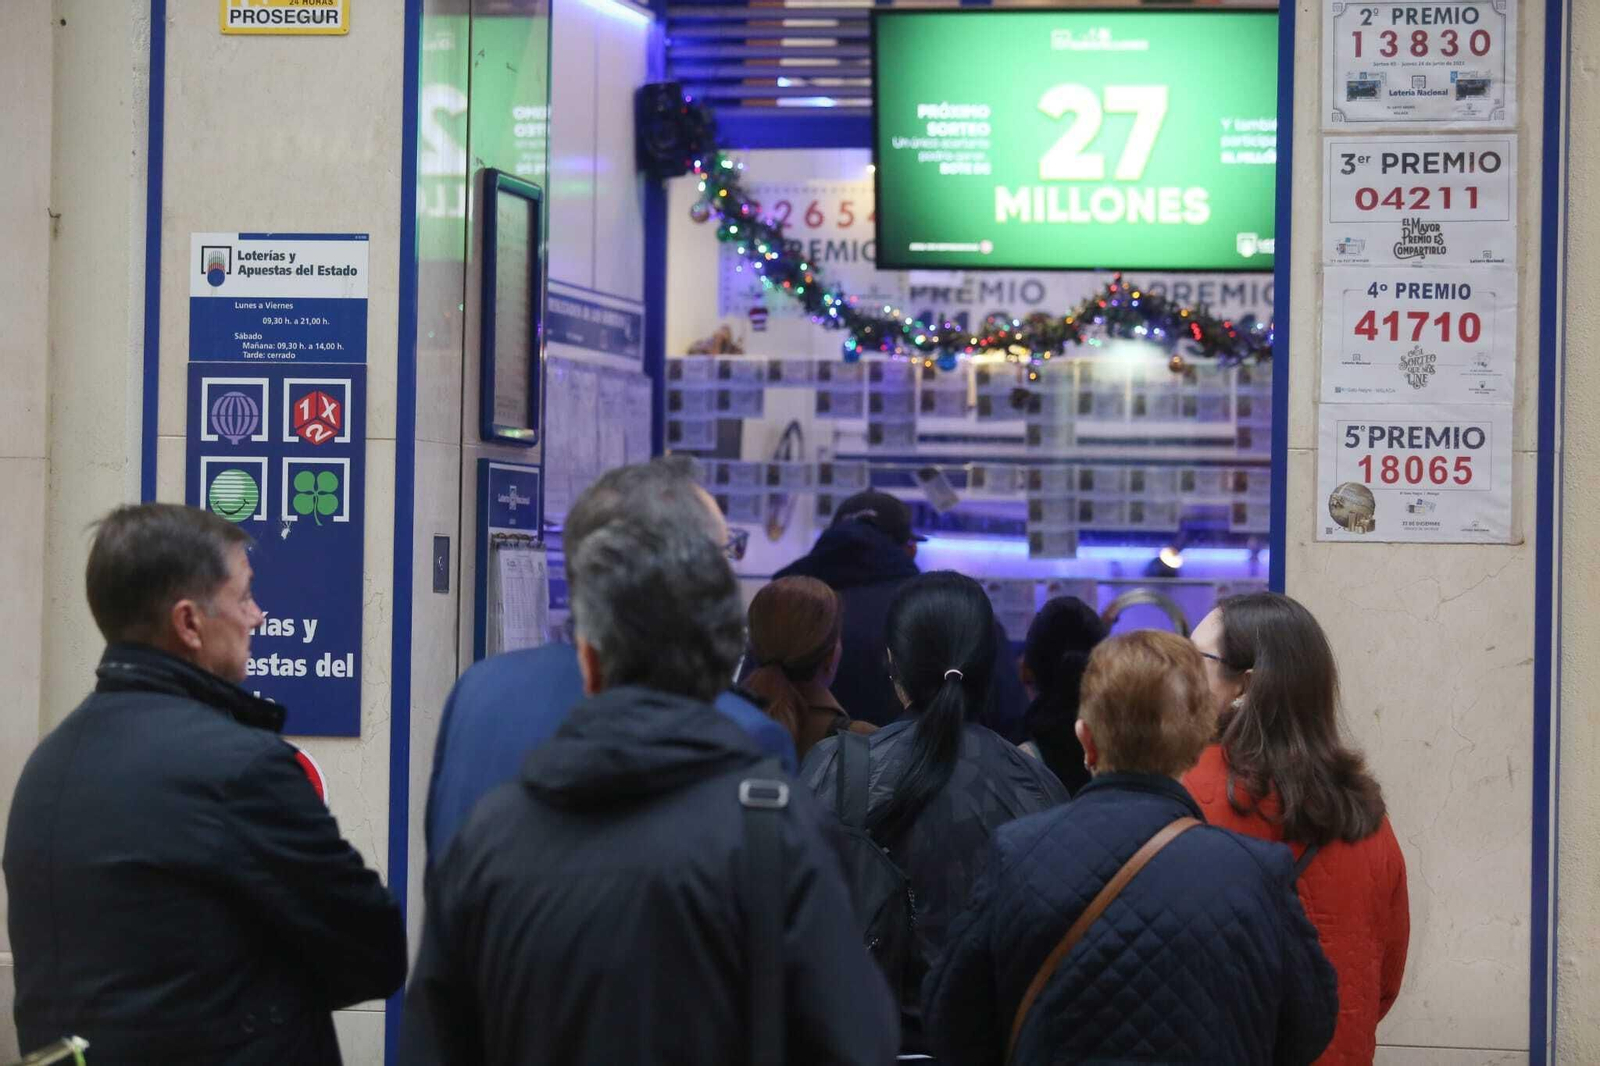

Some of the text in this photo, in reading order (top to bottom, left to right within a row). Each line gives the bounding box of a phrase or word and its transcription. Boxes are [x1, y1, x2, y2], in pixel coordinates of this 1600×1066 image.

[230, 9, 338, 24] PROSEGUR
[1392, 7, 1480, 25] PREMIO
[1352, 29, 1491, 58] 13830
[1417, 89, 1449, 97] Nacional
[1037, 82, 1169, 181] 27
[1381, 151, 1502, 174] PREMIO
[994, 186, 1211, 224] MILLONES
[1355, 186, 1478, 211] 04211
[1402, 218, 1410, 226] EL
[237, 250, 296, 264] Loterías y
[237, 264, 358, 278] Apuestas del Estado
[1395, 282, 1471, 300] PREMIO
[234, 302, 257, 310] Lunes
[265, 302, 294, 310] Viernes
[262, 317, 283, 326] 09,30
[285, 317, 293, 325] h.
[300, 317, 321, 326] 21,00
[322, 317, 330, 325] h.
[1354, 309, 1481, 343] 41710
[234, 332, 263, 340] Sábado
[242, 341, 276, 350] Mañana:
[277, 342, 298, 351] 09,30
[299, 342, 307, 350] h.
[315, 342, 335, 351] 14,00
[337, 342, 344, 350] h.
[1368, 425, 1486, 450] PREMIO
[1358, 455, 1473, 485] 18065
[302, 618, 318, 643] y
[316, 653, 354, 678] del
